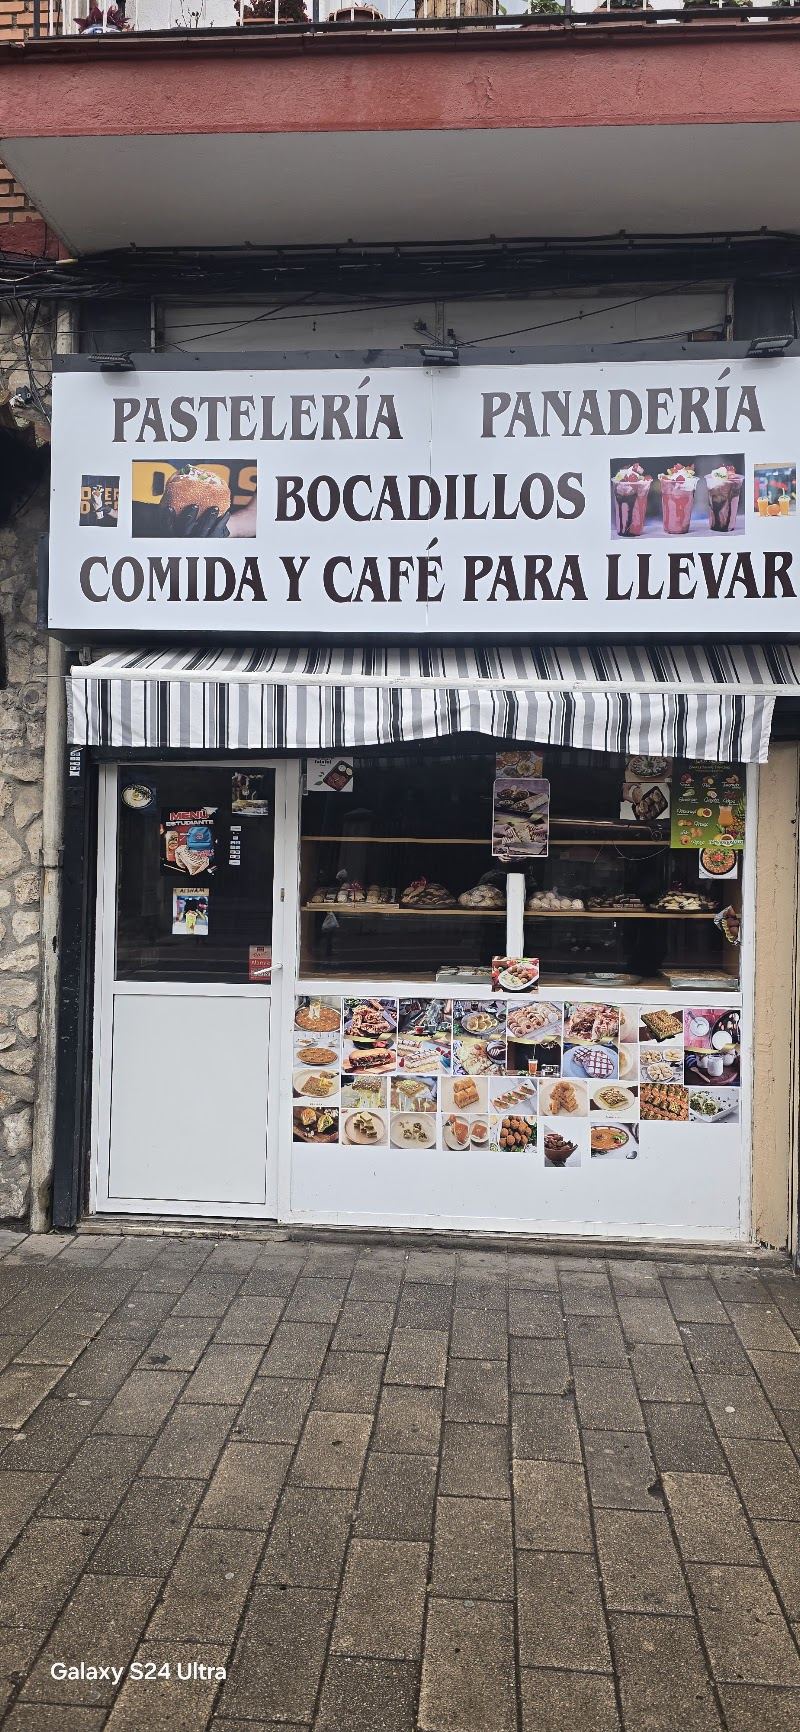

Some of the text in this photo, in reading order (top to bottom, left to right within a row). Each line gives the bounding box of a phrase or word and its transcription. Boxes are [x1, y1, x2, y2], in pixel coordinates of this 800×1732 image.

[112, 375, 403, 442] PASTELERÍA
[480, 366, 766, 438] PANADERÍA
[275, 472, 586, 522] BOCADILLOS
[80, 536, 798, 603] COMIDA Y CAFÉ PARA LLEVAR
